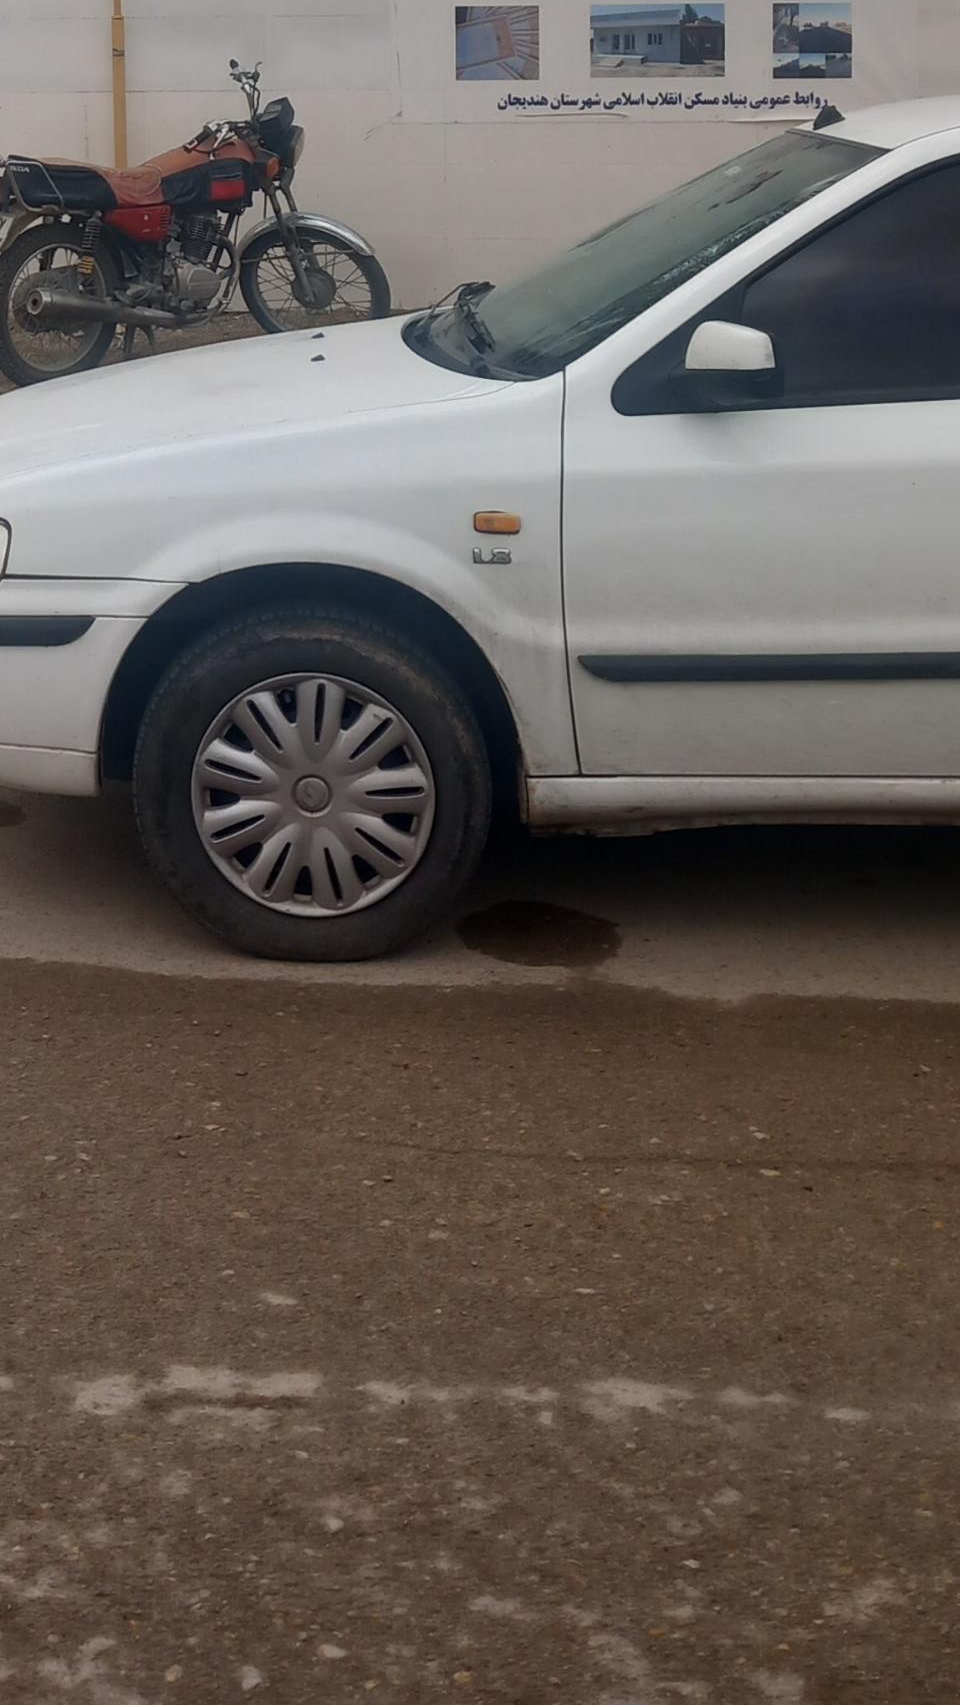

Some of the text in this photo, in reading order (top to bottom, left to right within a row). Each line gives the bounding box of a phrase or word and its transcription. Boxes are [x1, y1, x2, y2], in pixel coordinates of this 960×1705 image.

[497, 92, 828, 110] روابط عمومی بنیاد مسکن انقلاب اسلامی شهرستان هندیجان
